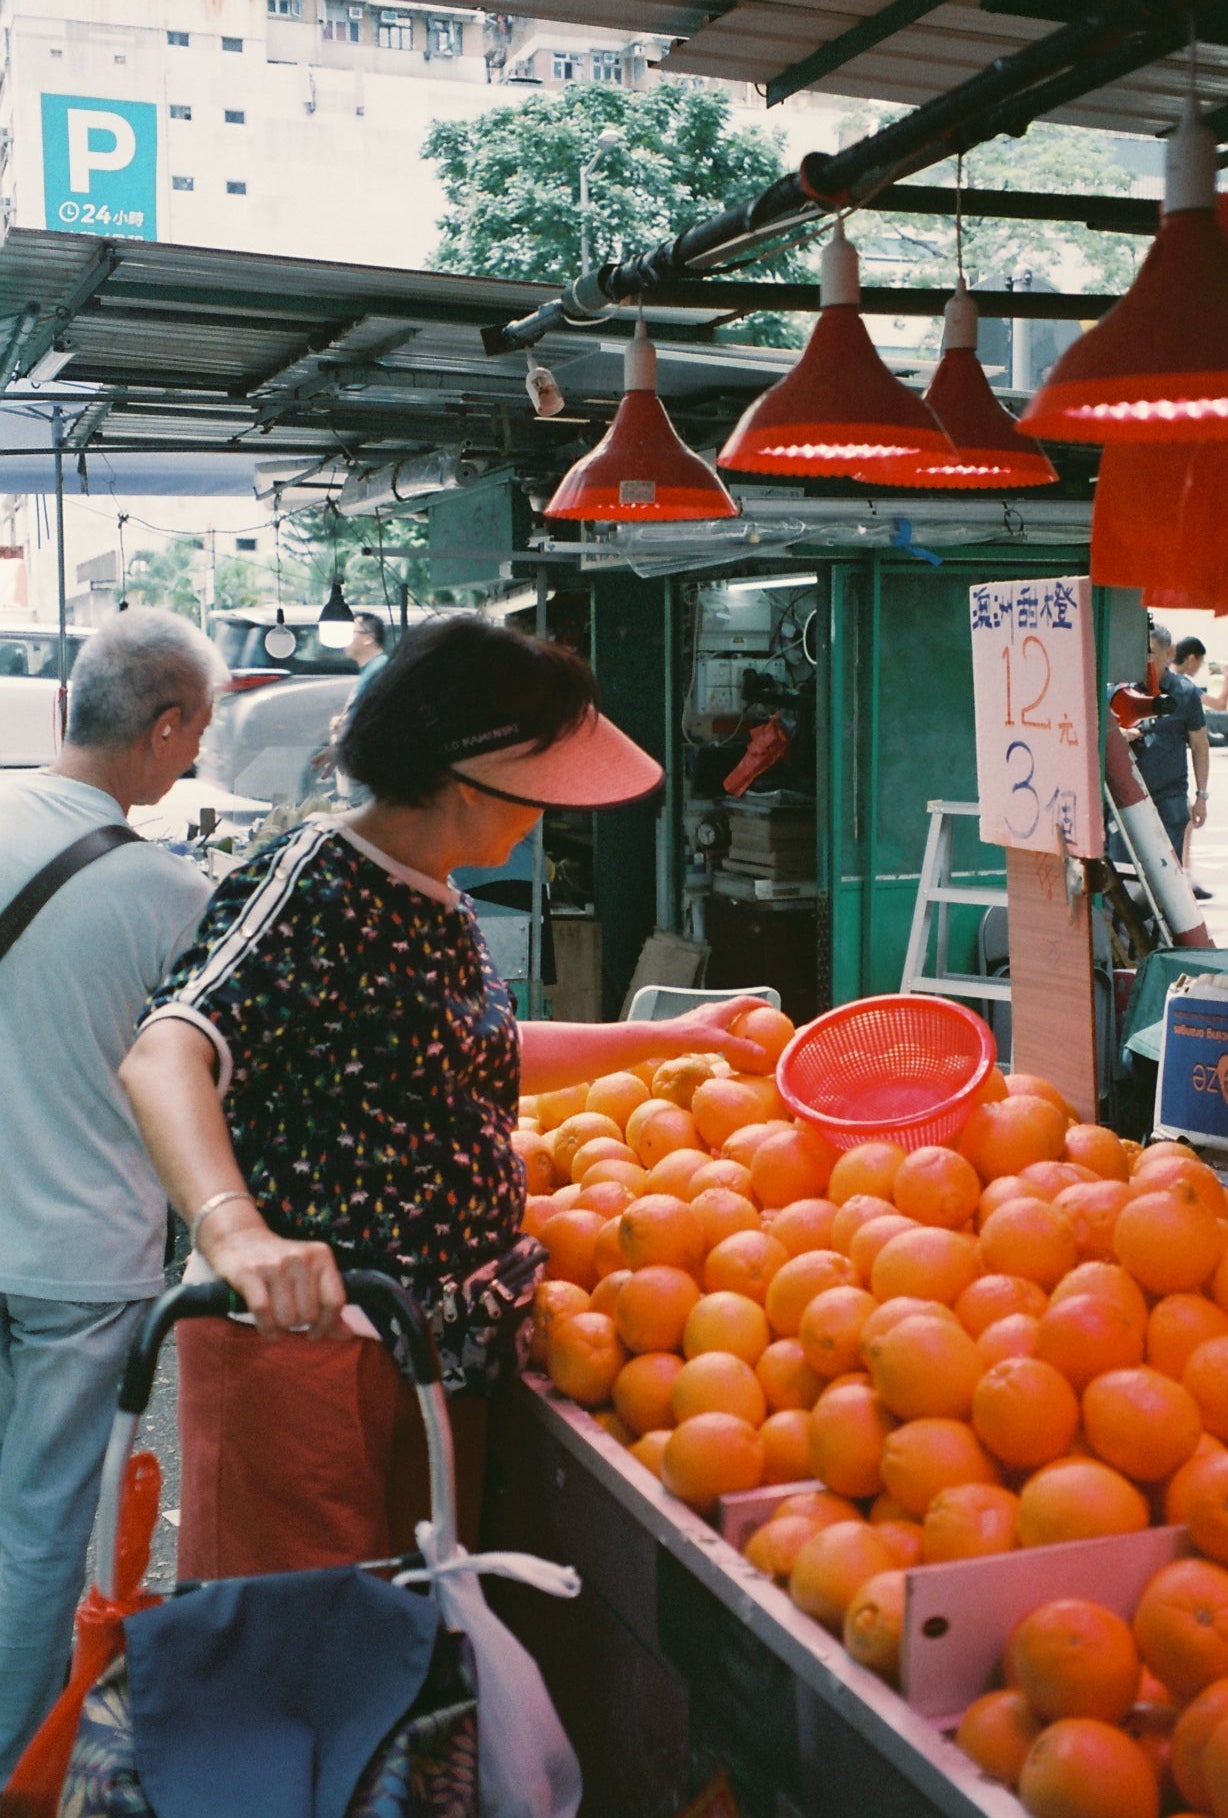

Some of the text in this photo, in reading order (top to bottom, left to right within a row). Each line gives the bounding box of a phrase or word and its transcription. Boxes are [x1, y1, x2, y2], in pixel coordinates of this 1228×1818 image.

[67, 108, 136, 193] P
[972, 582, 1078, 640] 澳洲甜橙
